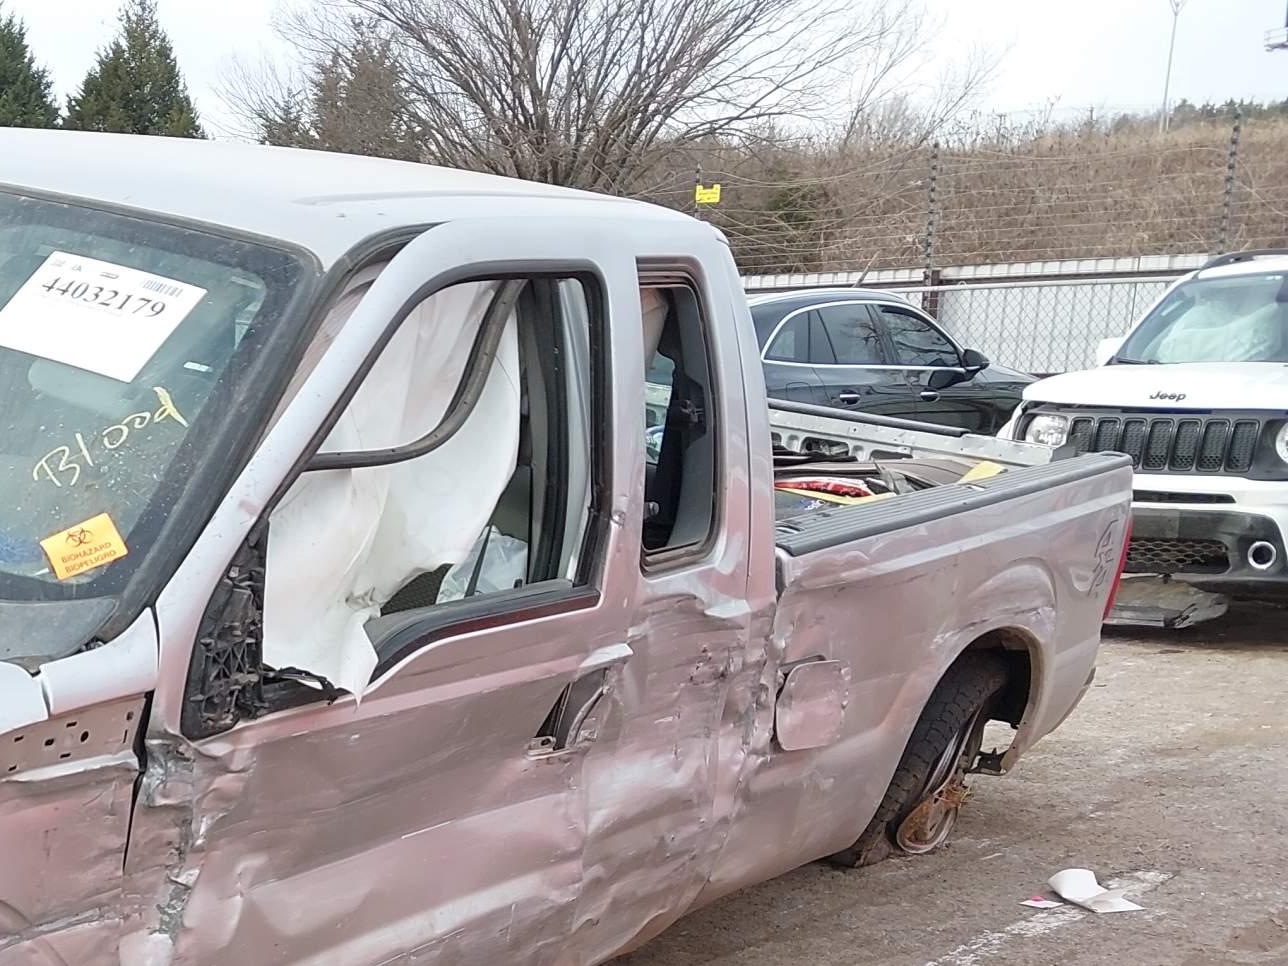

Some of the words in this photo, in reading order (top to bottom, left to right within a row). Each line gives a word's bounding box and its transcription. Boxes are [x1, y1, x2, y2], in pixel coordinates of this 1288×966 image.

[41, 276, 167, 318] 44032179
[1149, 390, 1187, 402] Jeep
[61, 541, 112, 563] BIOHAZARD
[64, 549, 117, 573] BIOPELIGRO
